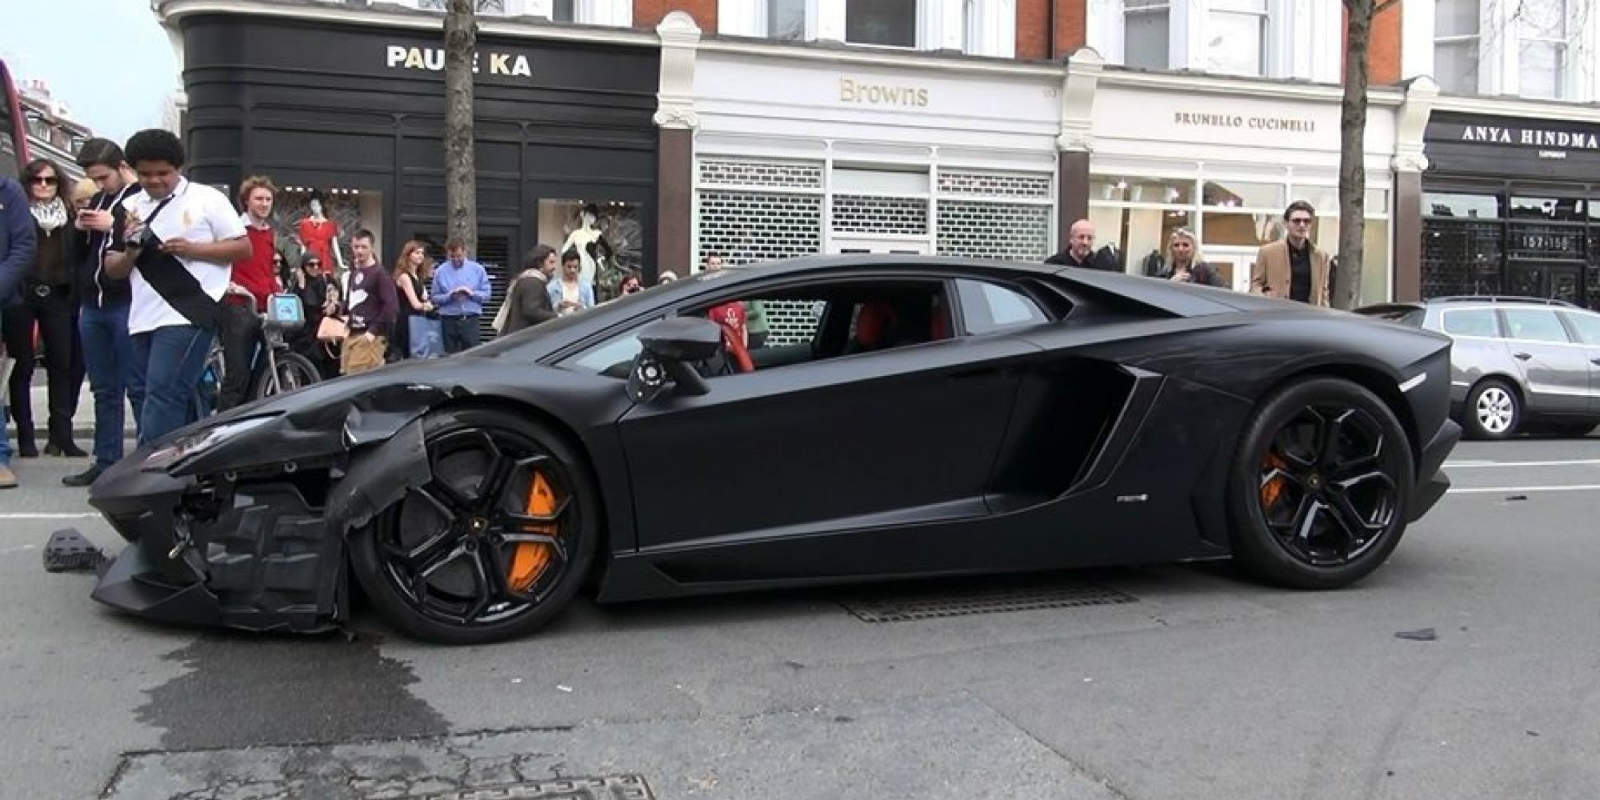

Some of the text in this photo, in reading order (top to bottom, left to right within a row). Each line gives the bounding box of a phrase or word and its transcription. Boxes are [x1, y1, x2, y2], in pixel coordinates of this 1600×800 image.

[387, 46, 531, 76] PAU KA
[839, 76, 929, 107] Browns
[1248, 117, 1315, 132] CUCINELLI
[1462, 126, 1599, 148] ANYA HINDMA
